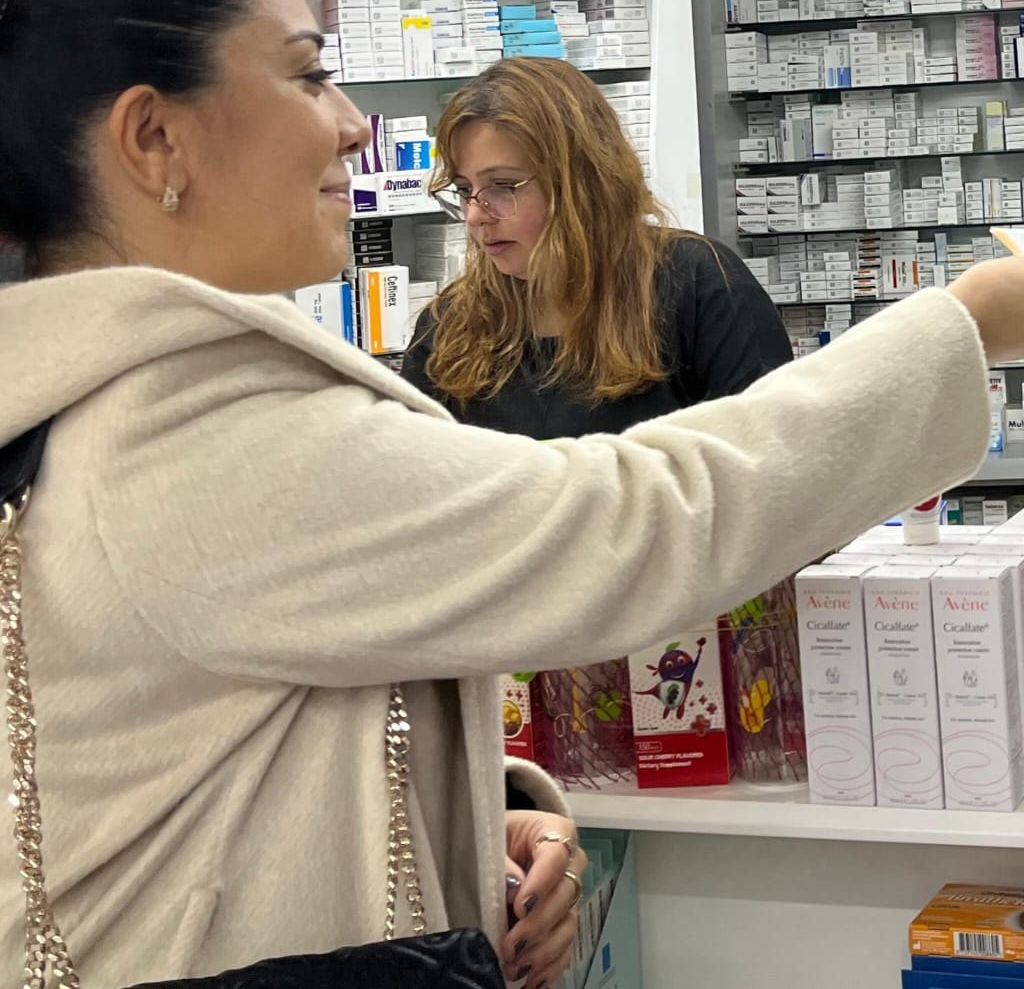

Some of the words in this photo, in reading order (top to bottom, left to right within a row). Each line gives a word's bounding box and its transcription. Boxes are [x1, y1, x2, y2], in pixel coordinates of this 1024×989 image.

[385, 178, 422, 191] Dynabac
[807, 595, 850, 610] Avène
[875, 596, 919, 611] Avène
[944, 596, 989, 611] Avène
